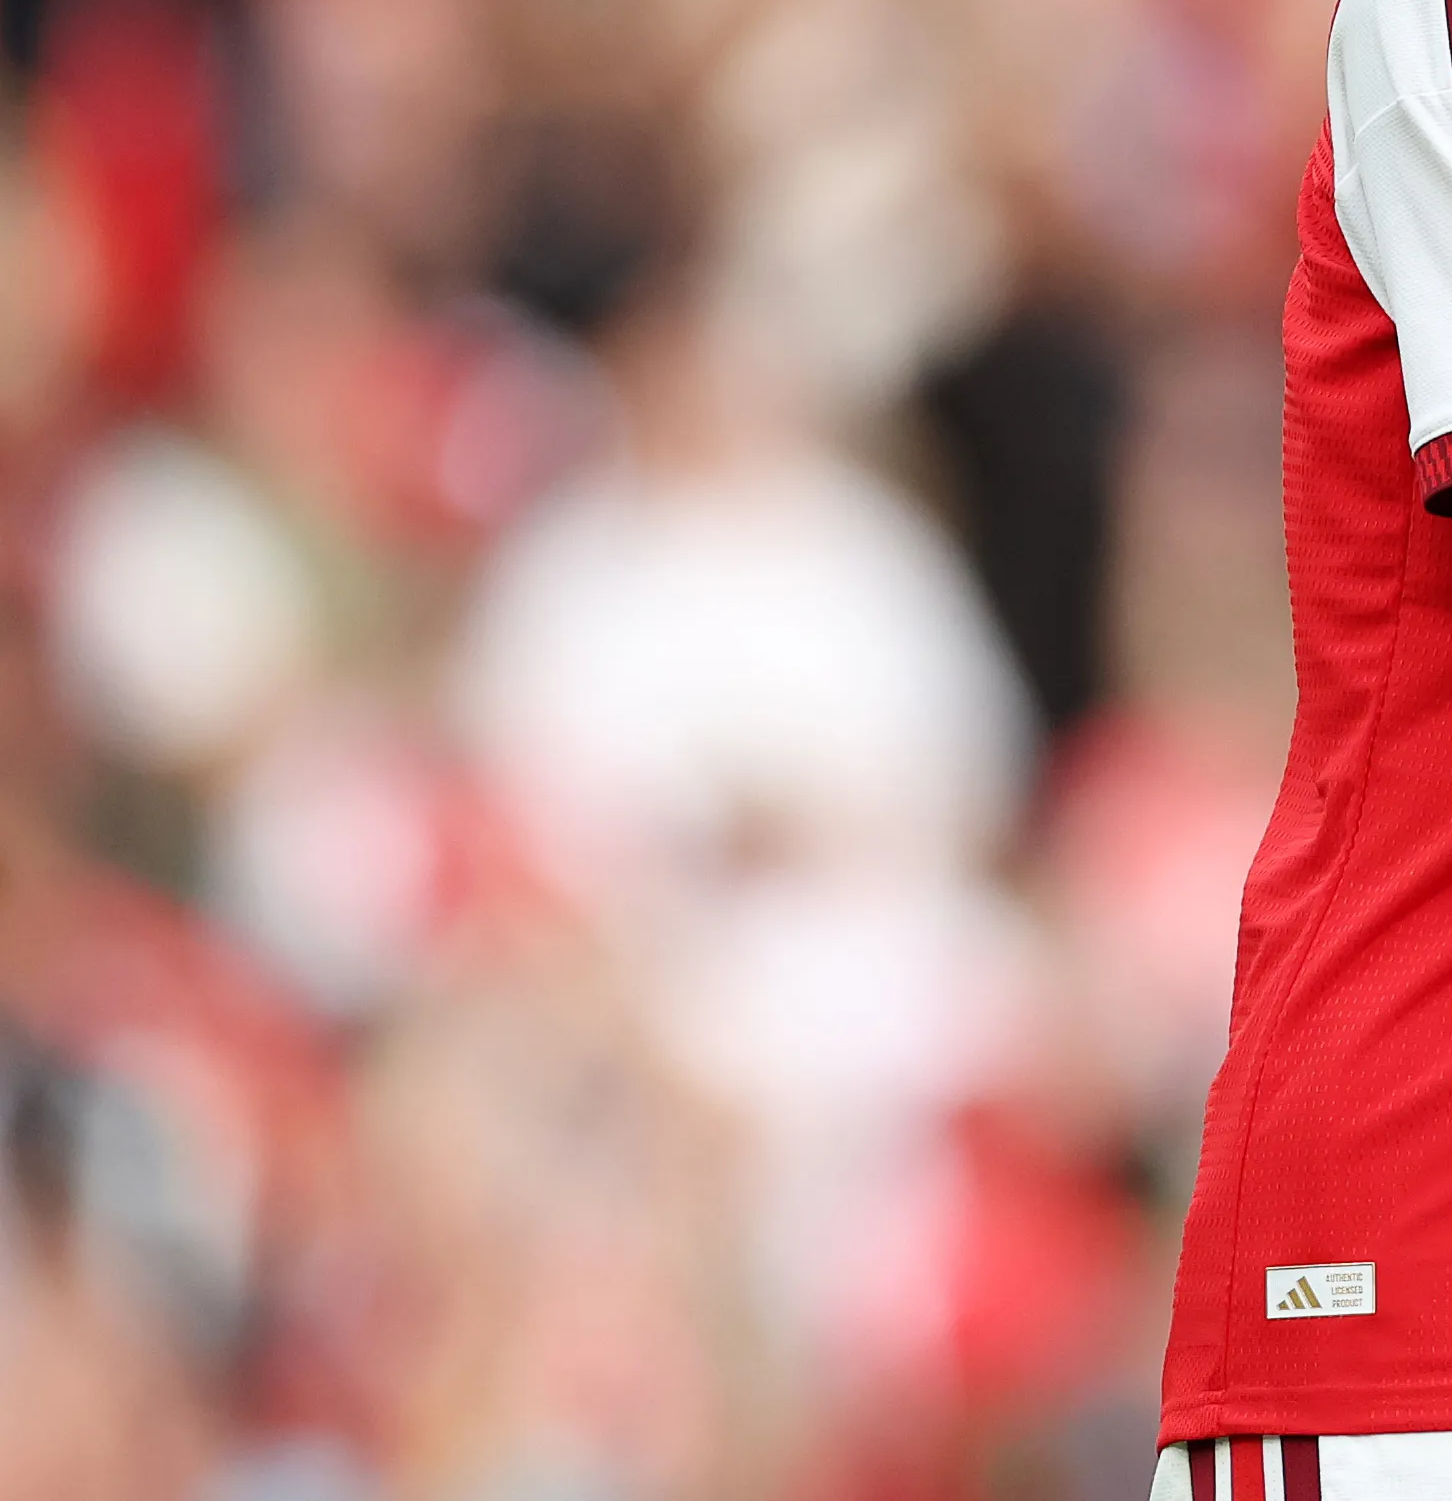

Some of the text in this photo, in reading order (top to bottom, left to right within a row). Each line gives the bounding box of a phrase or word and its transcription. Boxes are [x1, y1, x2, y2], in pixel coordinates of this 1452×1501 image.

[1325, 1272, 1363, 1283] AUTHENTIC
[1331, 1285, 1363, 1296] LICENSED
[1332, 1298, 1363, 1308] PRODUCT
